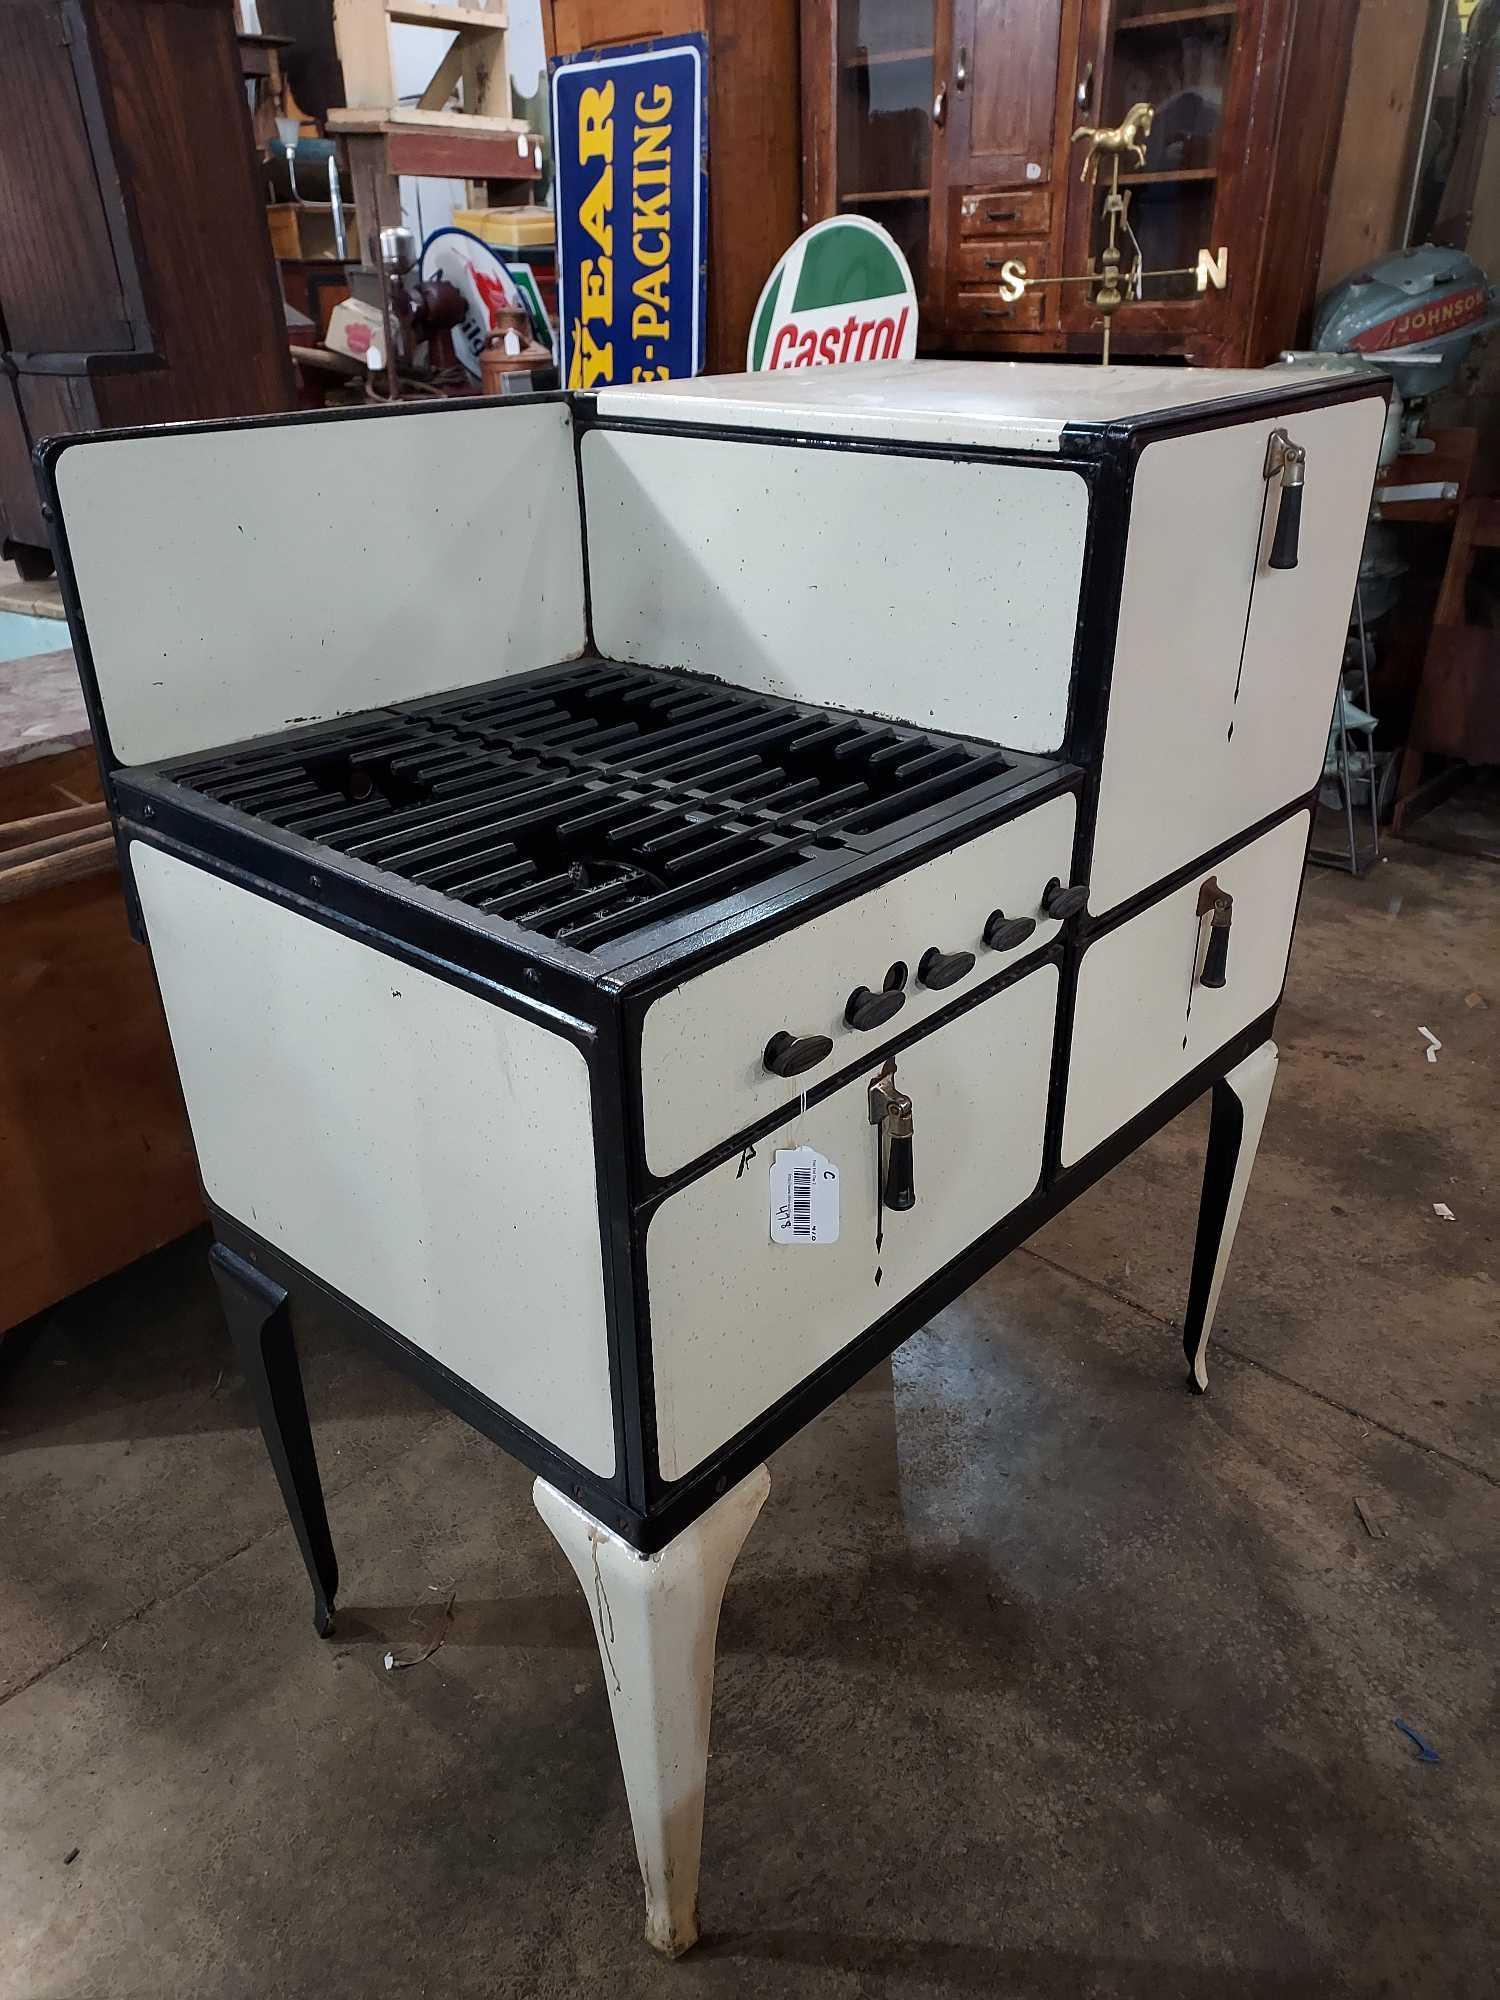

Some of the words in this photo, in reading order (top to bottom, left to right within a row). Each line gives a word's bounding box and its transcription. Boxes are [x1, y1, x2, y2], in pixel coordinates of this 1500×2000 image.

[999, 259, 1026, 303] S
[1197, 246, 1228, 292] N
[769, 306, 909, 370] Castrol
[824, 1171, 835, 1179] C
[775, 1205, 792, 1229] 478
